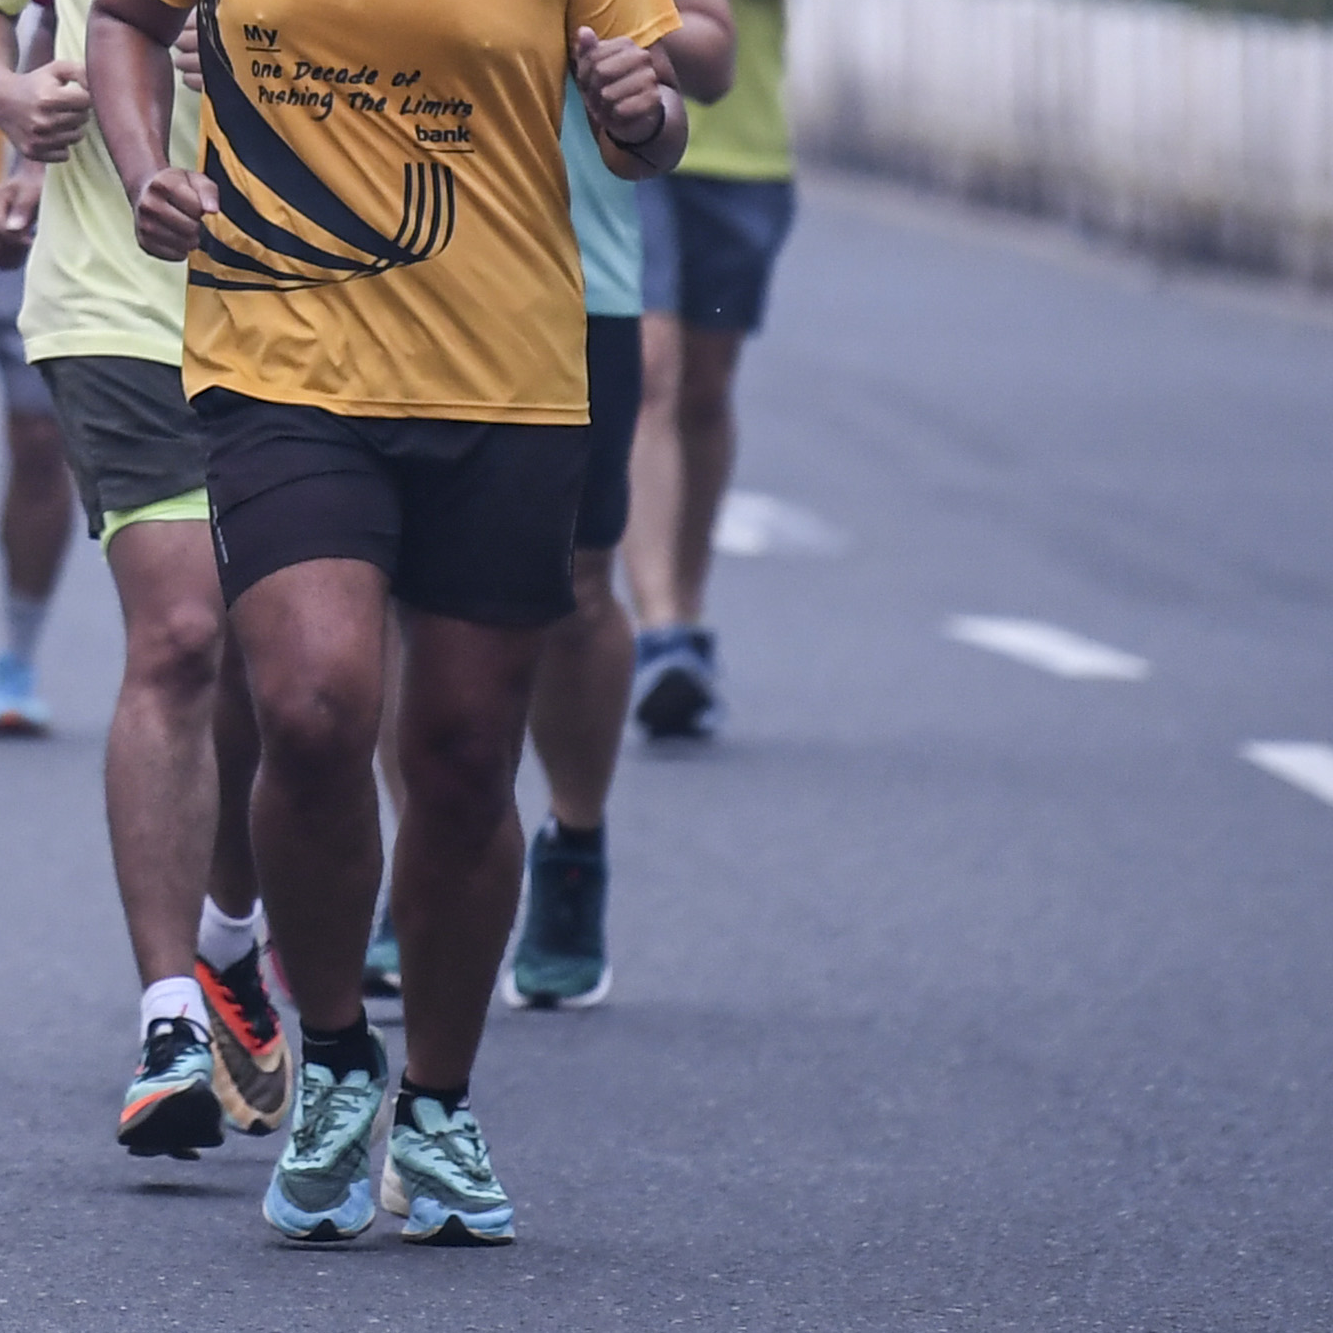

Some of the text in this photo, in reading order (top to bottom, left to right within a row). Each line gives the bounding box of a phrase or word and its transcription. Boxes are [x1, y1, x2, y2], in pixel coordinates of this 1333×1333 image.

[243, 24, 279, 48] My
[251, 60, 422, 87] One Decade of
[257, 84, 473, 122] Pushing The Limits
[414, 124, 470, 143] bank
